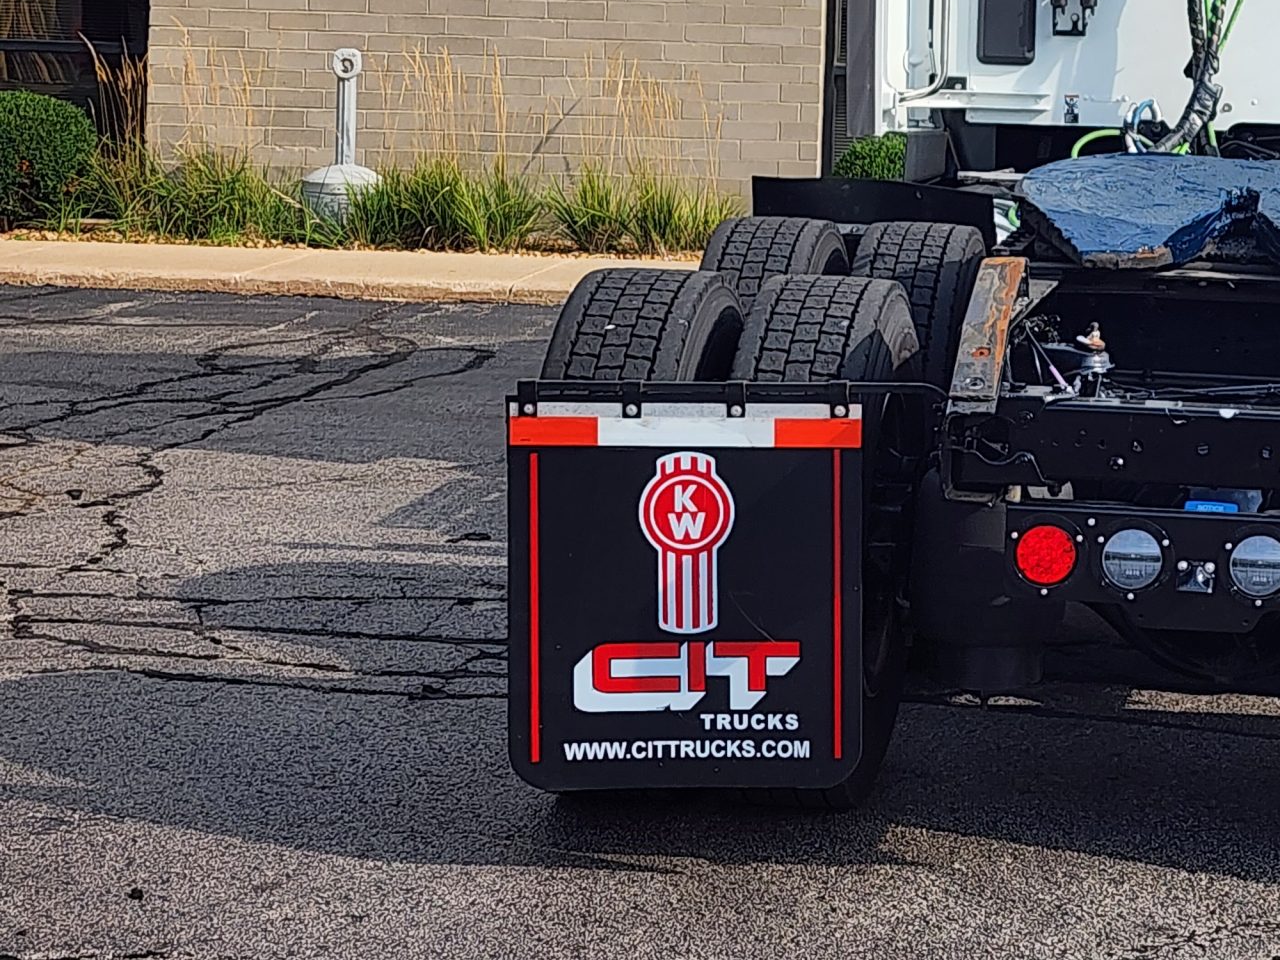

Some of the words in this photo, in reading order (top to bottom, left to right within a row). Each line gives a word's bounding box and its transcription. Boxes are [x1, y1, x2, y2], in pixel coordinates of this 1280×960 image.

[674, 484, 697, 512] K
[668, 513, 706, 539] W
[573, 641, 801, 713] CIT
[700, 713, 799, 730] TRUCKS
[564, 740, 811, 761] WWW.CITTRUCKS.COM
